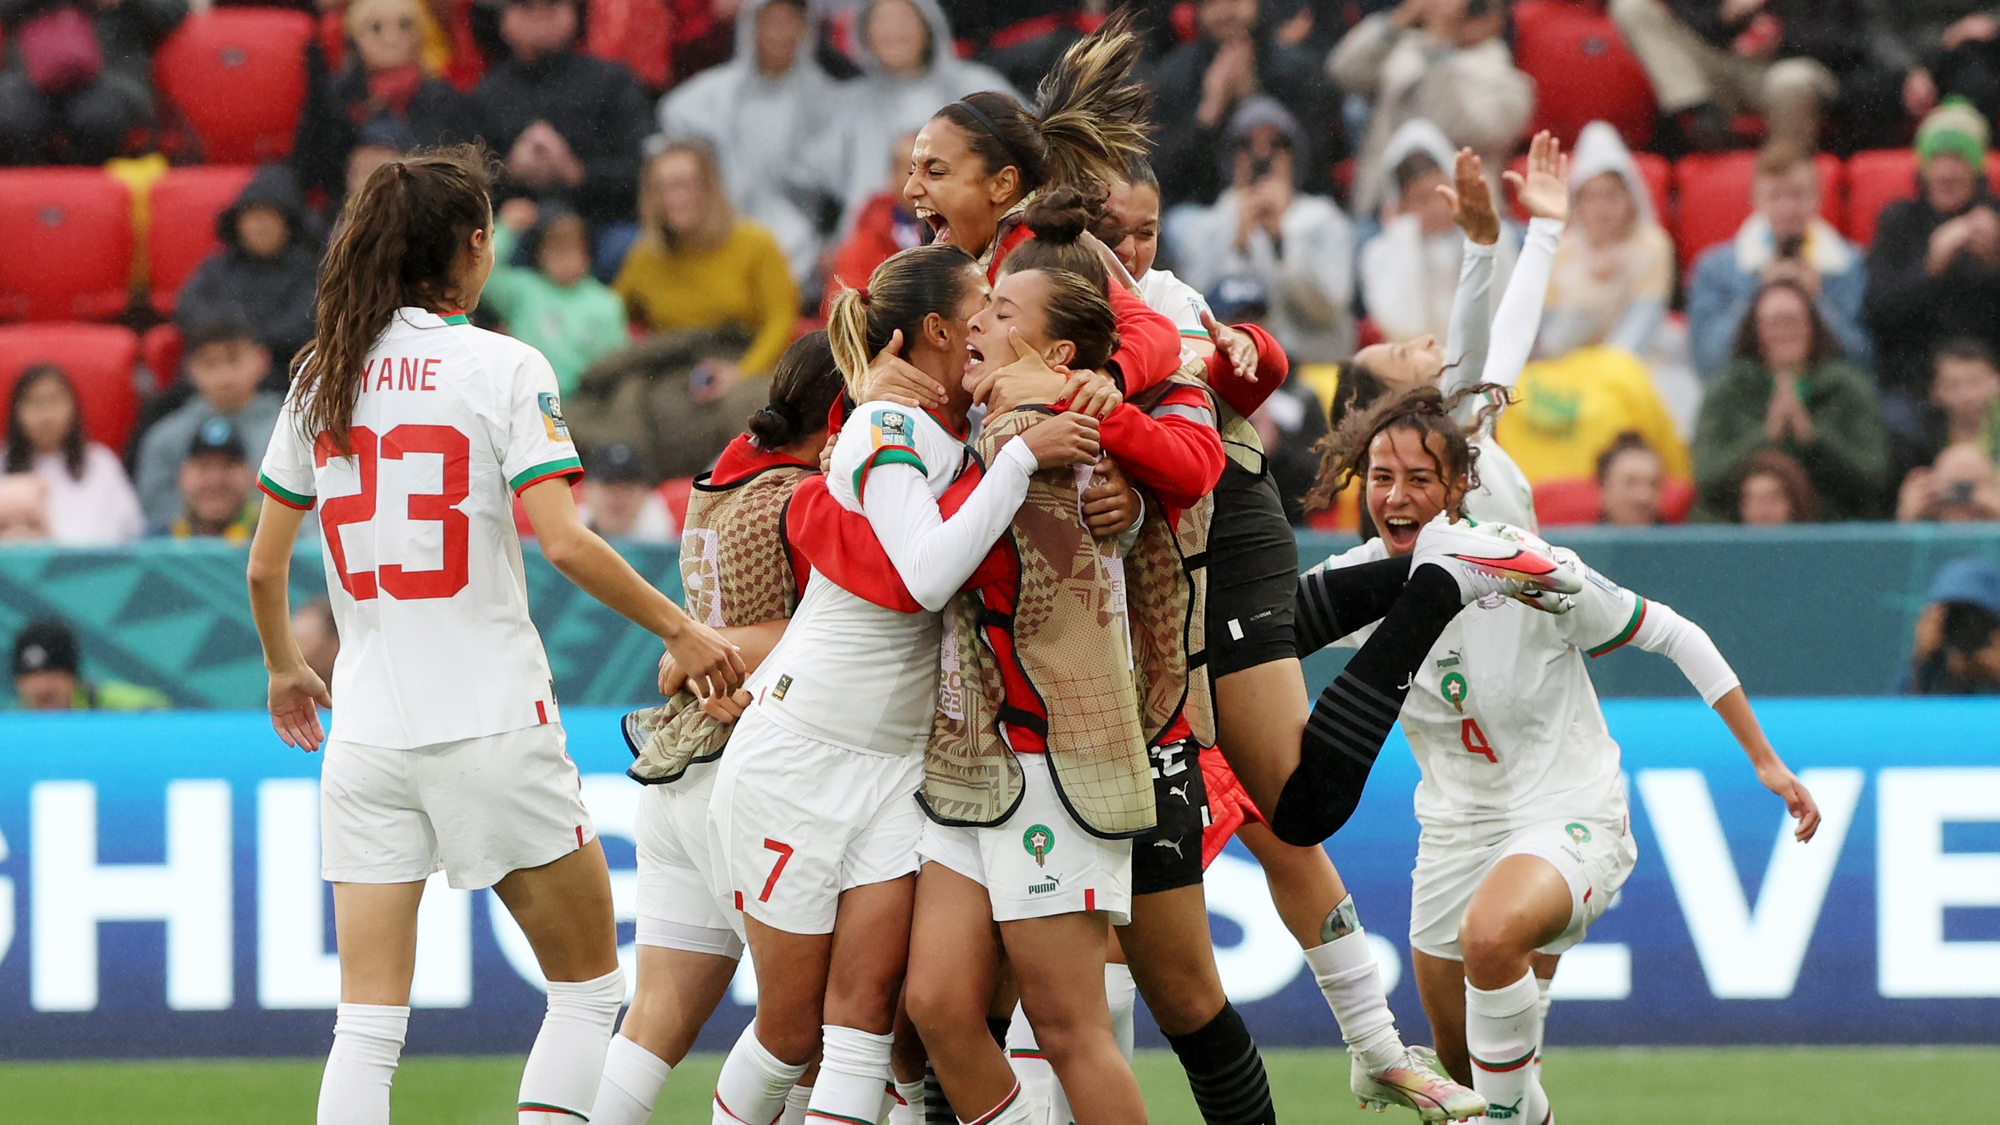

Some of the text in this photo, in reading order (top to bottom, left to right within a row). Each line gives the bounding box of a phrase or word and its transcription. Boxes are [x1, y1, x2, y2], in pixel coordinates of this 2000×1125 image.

[361, 357, 443, 394] YANE
[314, 424, 470, 601] 23
[1436, 656, 1461, 669] PUMA
[1461, 717, 1499, 764] 4
[758, 837, 795, 904] 7
[1028, 882, 1057, 895] PUMA
